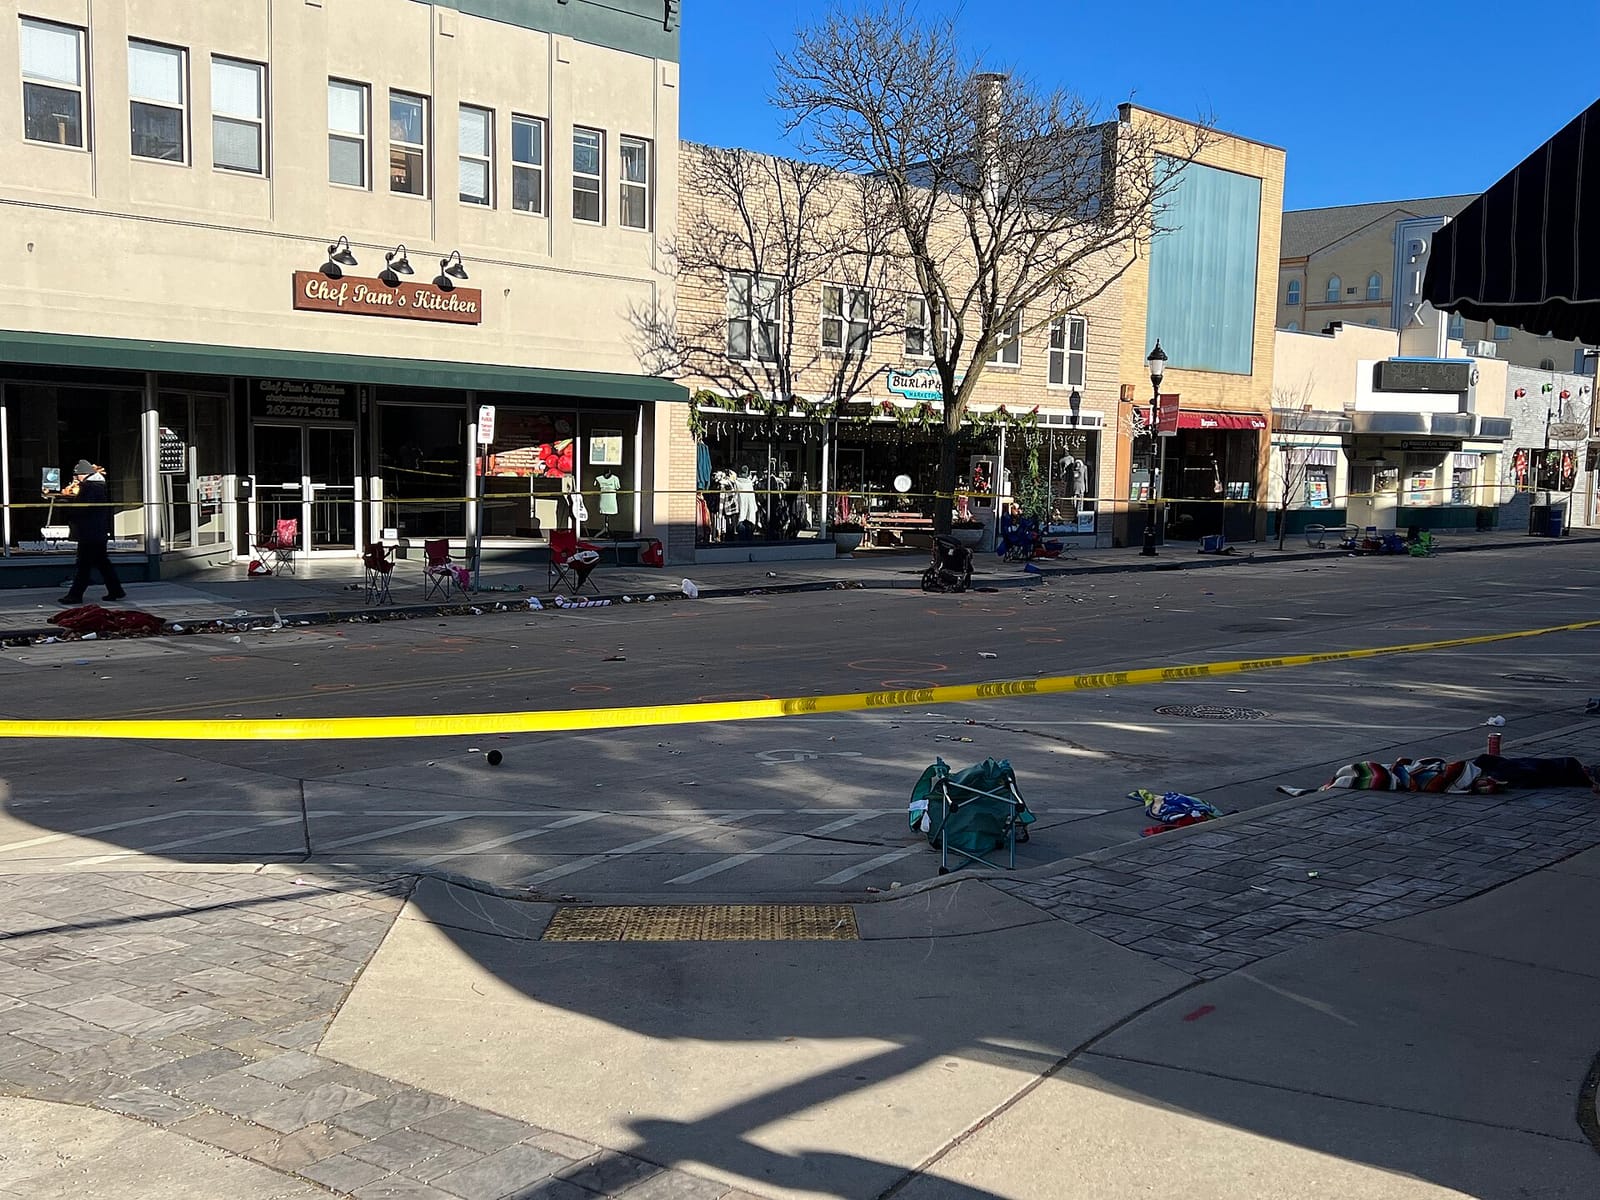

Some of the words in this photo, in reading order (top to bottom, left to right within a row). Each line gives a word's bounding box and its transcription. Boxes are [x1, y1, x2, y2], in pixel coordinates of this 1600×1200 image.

[305, 279, 349, 306] Chef
[352, 284, 407, 306] Pam's
[412, 290, 478, 313] Kitchen
[260, 381, 281, 395] Chef
[311, 384, 345, 395] Kitchen
[892, 376, 935, 389] BURLAP
